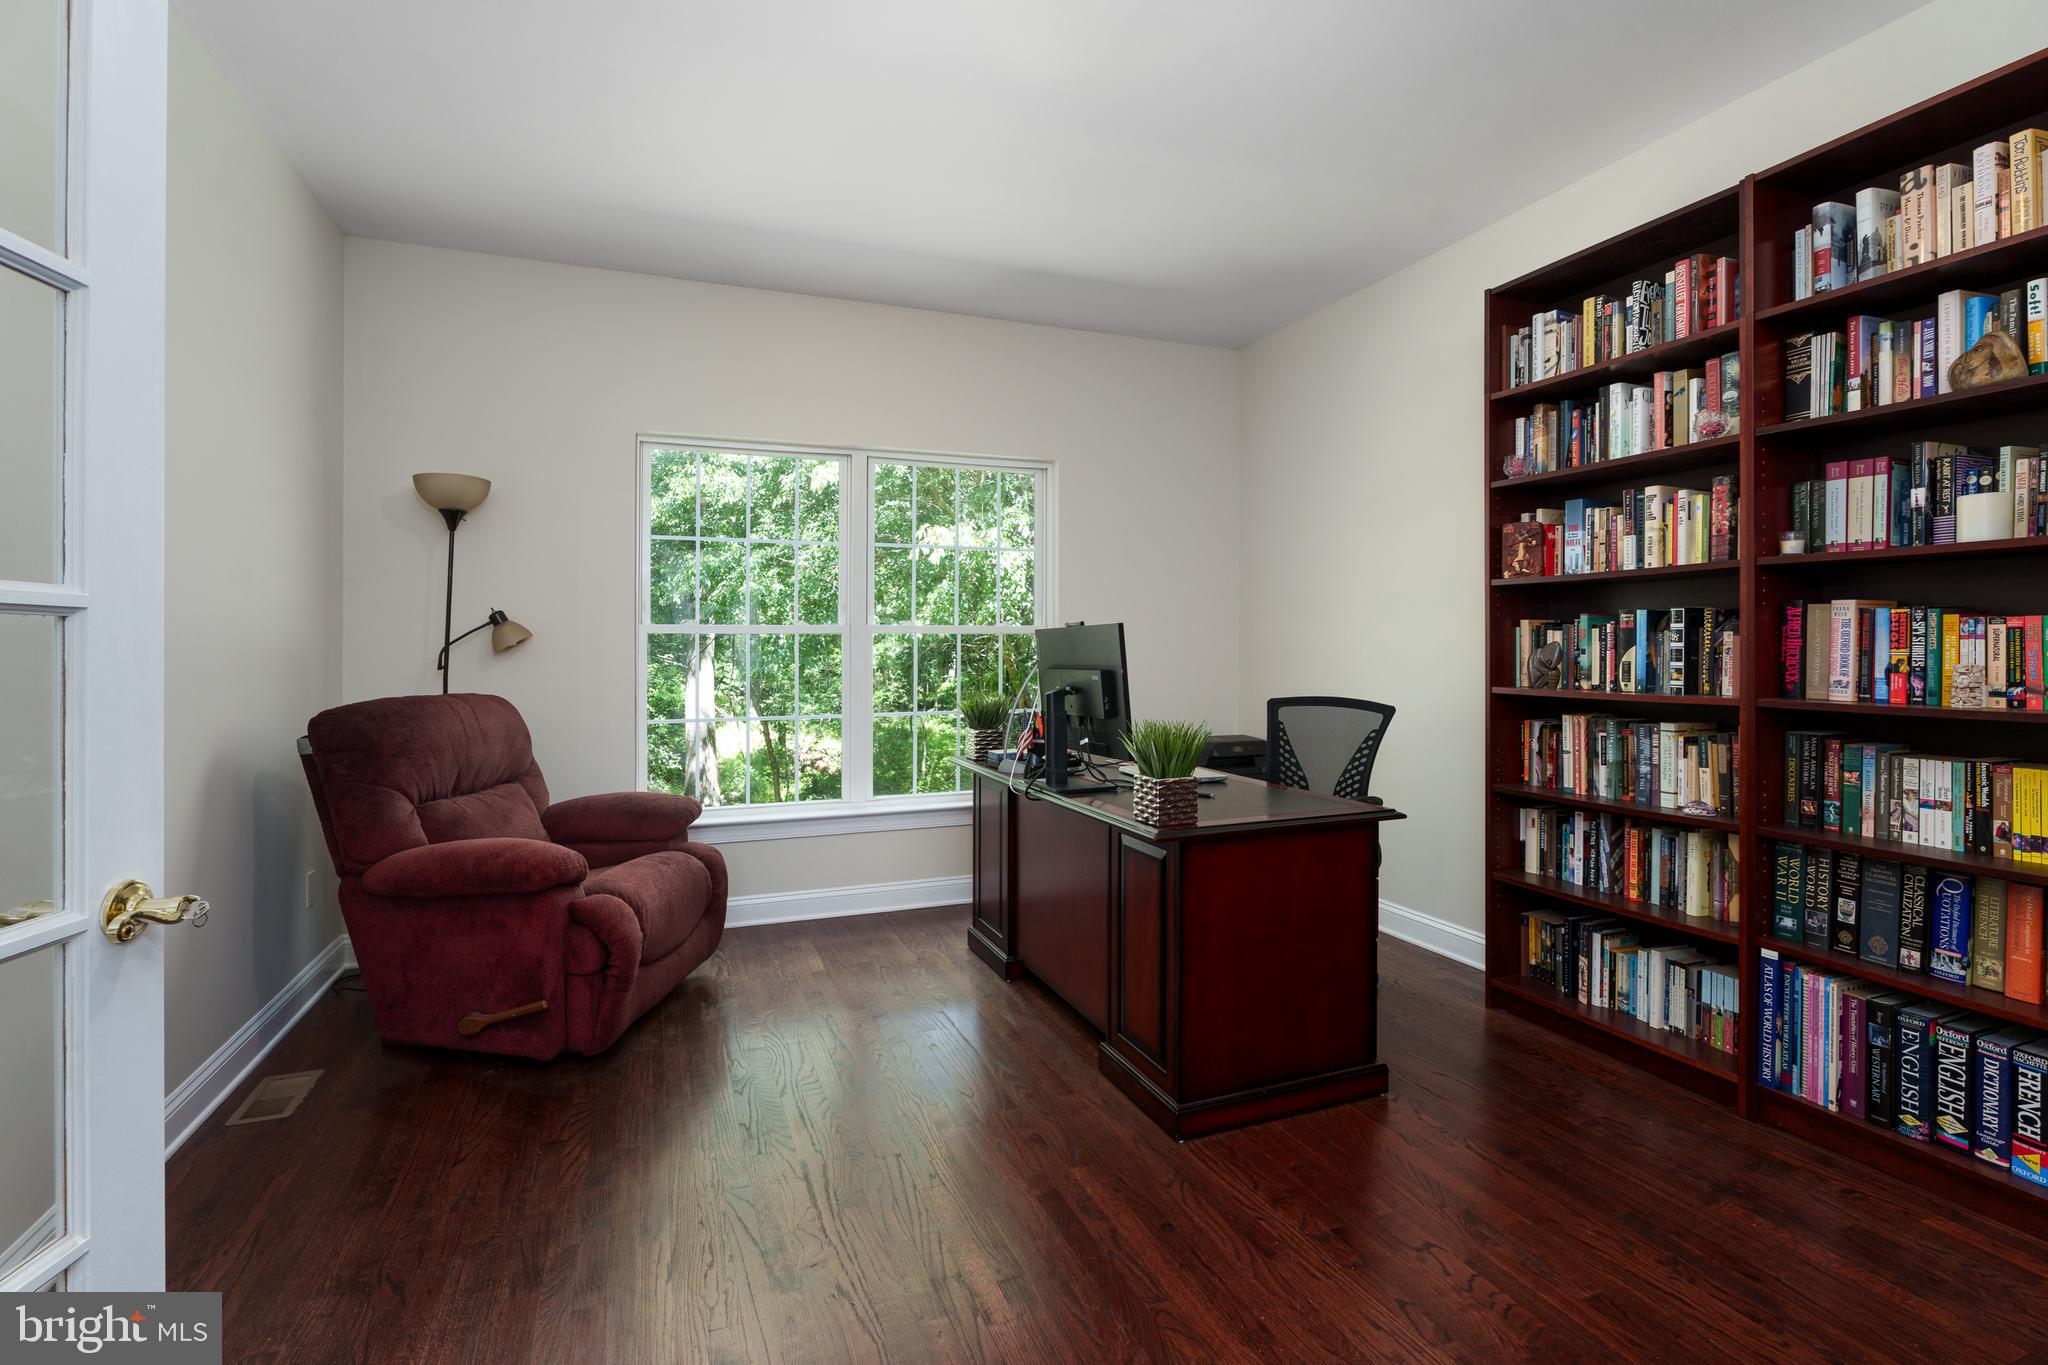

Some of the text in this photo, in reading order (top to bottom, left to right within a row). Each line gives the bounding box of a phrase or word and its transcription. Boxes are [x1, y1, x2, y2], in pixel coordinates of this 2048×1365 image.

[1937, 168, 1946, 199] VINELAND
[2013, 135, 2029, 195] Tom Robbins
[1916, 192, 1924, 240] Thomas Pynchon
[1596, 298, 1604, 317] train
[1675, 264, 1687, 340] BESTSELLER GOLDSMITH
[2008, 298, 2017, 312] The
[2029, 284, 2041, 315] Soft!
[1707, 371, 1716, 392] QUO
[1942, 457, 1951, 503] RABBIT AT REST
[1785, 606, 1803, 683] ALFRED HITCHCOCK
[1839, 618, 1851, 679] THE OXFORD BOOK OF
[1890, 613, 1899, 649] DUOS
[1899, 613, 1907, 648] DETECTIVE
[1911, 621, 1926, 667] SPY STORIES
[1992, 628, 2000, 662] SUPERNATURAL
[1810, 736, 1818, 757] MAJOR
[1787, 757, 1796, 802] DISCOVERIES
[1865, 769, 1873, 814] Animal Stories
[1776, 856, 1788, 886] WAR
[1788, 857, 1801, 904] WORLD
[1805, 865, 1816, 907] WORLD
[1816, 858, 1829, 911] HISTORY
[1776, 890, 1787, 901] II
[1900, 873, 1913, 938] CIVILIZATION
[1912, 875, 1926, 928] CLASSICAL
[1936, 878, 1964, 950] QUOTATIONS
[1952, 904, 1960, 920] Oxford
[1953, 895, 1961, 903] The
[1978, 894, 1989, 941] IN FRENCH
[1951, 921, 1960, 944] Dictionary
[1988, 896, 2000, 949] LITERATURE
[1934, 969, 1960, 980] OXFORD
[1762, 963, 1774, 1082] ATLAS OF WORLD HISTORY
[1782, 974, 1791, 1071] ENCYCLOPEDIC WORLD ATLAS
[1897, 1015, 1926, 1028] OXFORD
[1936, 1025, 1970, 1043] Oxford
[1976, 1039, 2008, 1055] Oxford
[2013, 1049, 2048, 1067] OXFORD
[1871, 1048, 1880, 1104] WESTERN ART
[1901, 1028, 1920, 1115] ENGLISH
[1937, 1041, 1967, 1120] ENGLISH
[1982, 1057, 2000, 1132] DICTIONARY
[2017, 1066, 2041, 1142] FRENCH
[2012, 1165, 2048, 1184] OXFORD
[2021, 1154, 2039, 1167] New
